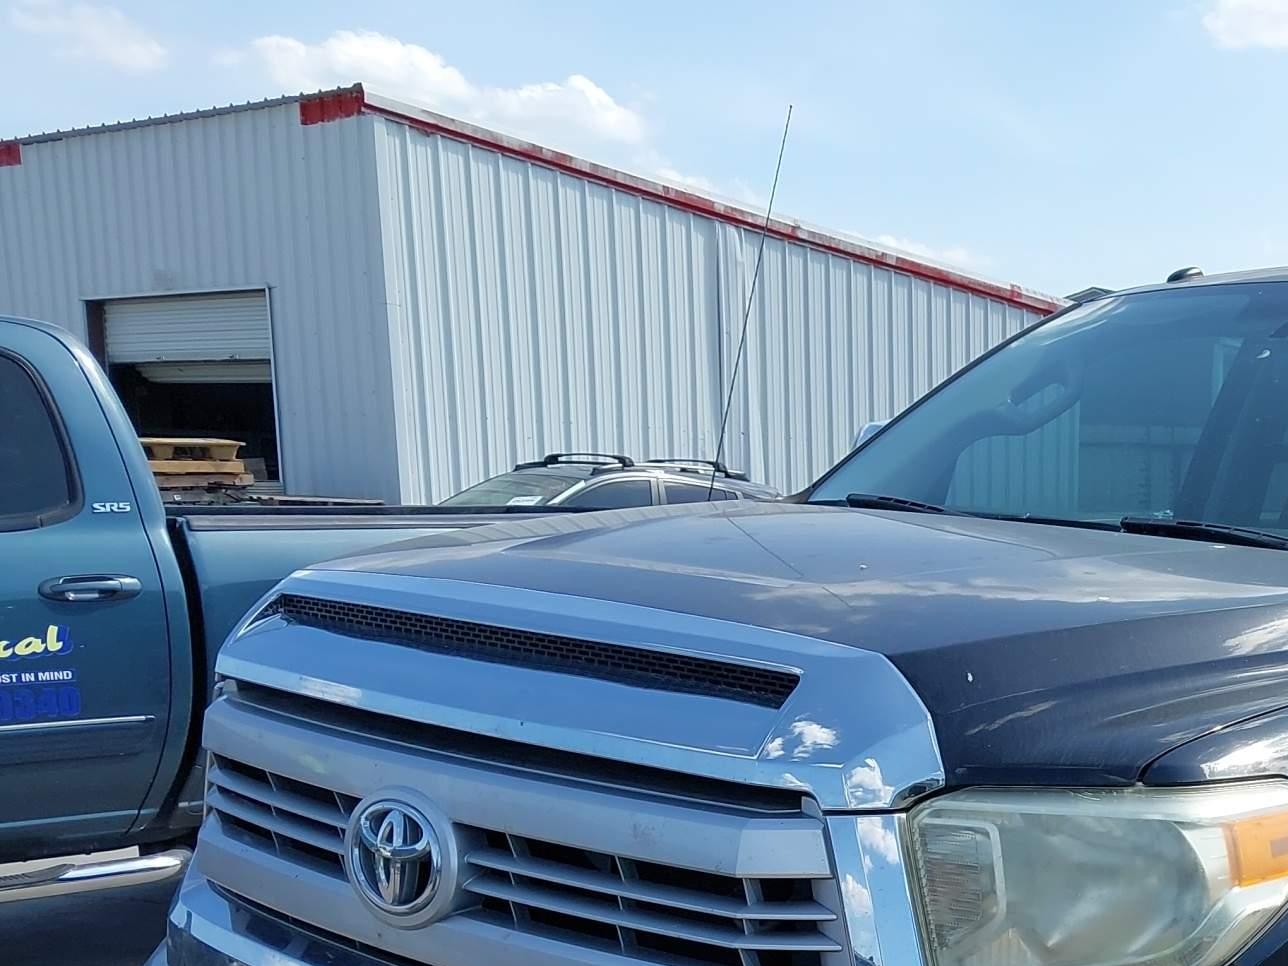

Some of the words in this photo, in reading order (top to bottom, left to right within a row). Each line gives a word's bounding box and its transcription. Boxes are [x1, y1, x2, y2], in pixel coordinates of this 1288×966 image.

[92, 502, 131, 513] SR5
[0, 673, 18, 683] ST
[21, 672, 35, 682] IN
[38, 671, 73, 681] MIND
